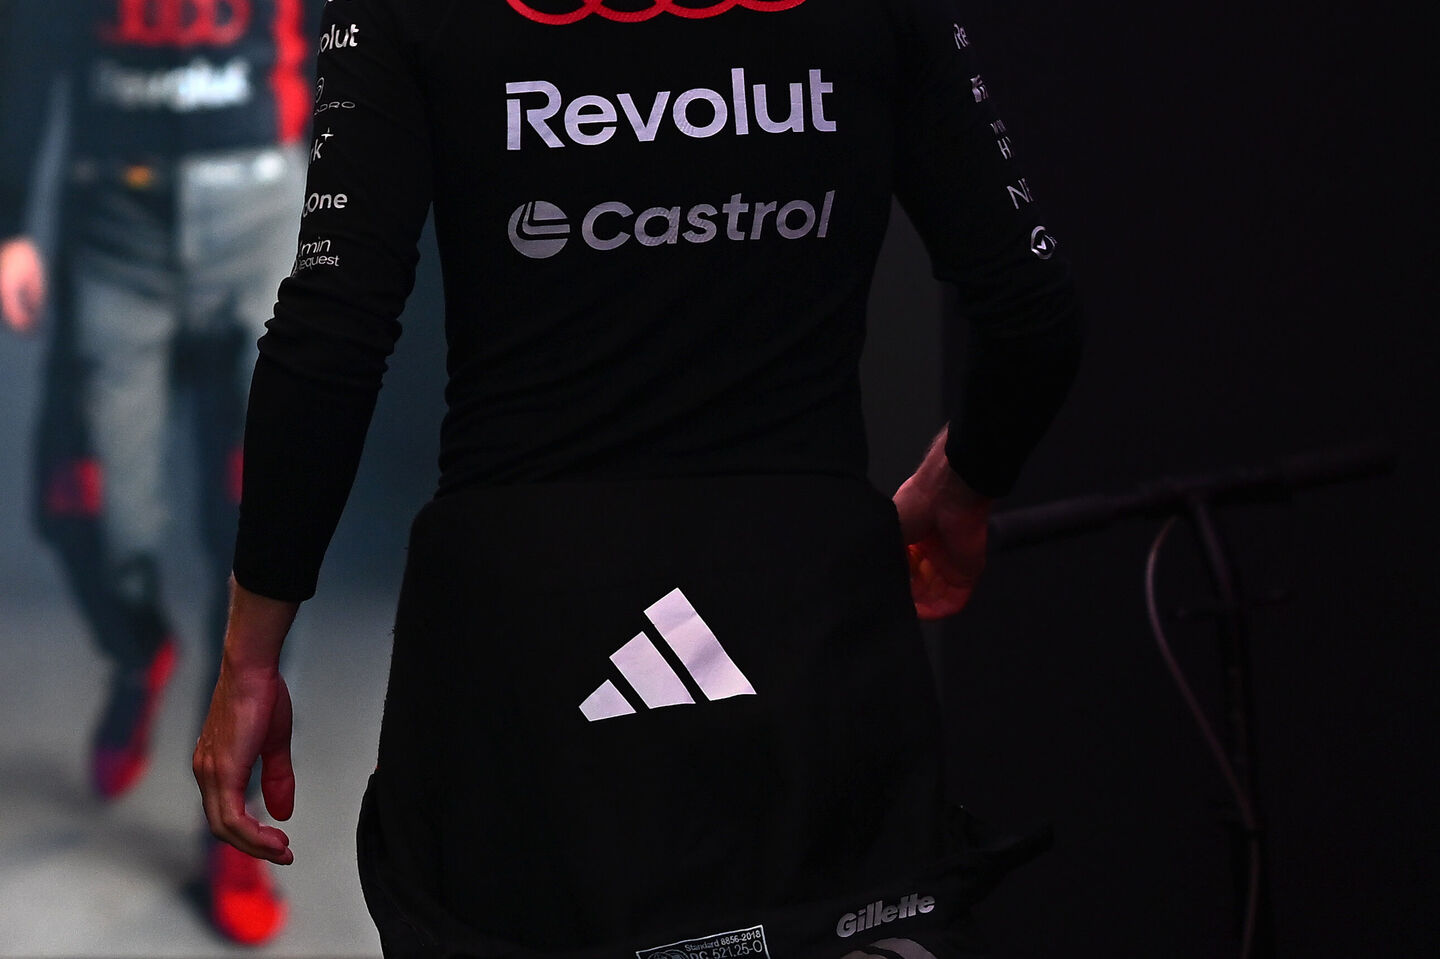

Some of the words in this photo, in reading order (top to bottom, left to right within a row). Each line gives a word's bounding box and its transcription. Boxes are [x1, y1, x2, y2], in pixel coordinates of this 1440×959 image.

[505, 67, 837, 151] Revolut
[580, 189, 837, 252] Castrol
[684, 940, 720, 952] Standard
[720, 929, 762, 946] 8856-2018
[836, 892, 937, 938] Gillette
